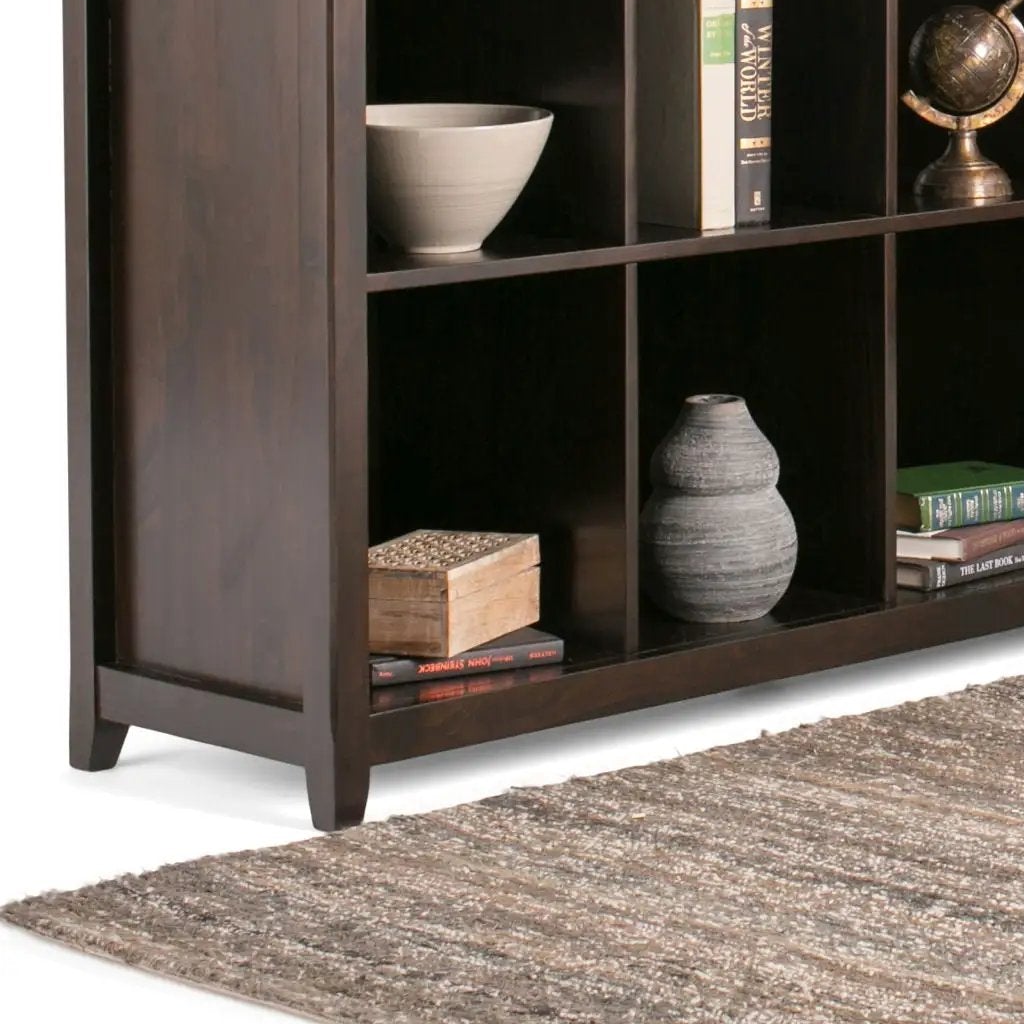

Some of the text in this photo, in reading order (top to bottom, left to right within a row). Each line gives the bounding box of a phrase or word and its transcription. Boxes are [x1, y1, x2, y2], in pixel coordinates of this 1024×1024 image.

[757, 24, 772, 120] WINTER
[740, 49, 757, 122] WORLD
[960, 562, 976, 577] THE
[976, 559, 994, 573] LAST
[994, 555, 1014, 569] BOOK
[417, 659, 465, 674] STEINBECK
[468, 654, 492, 668] JOHN
